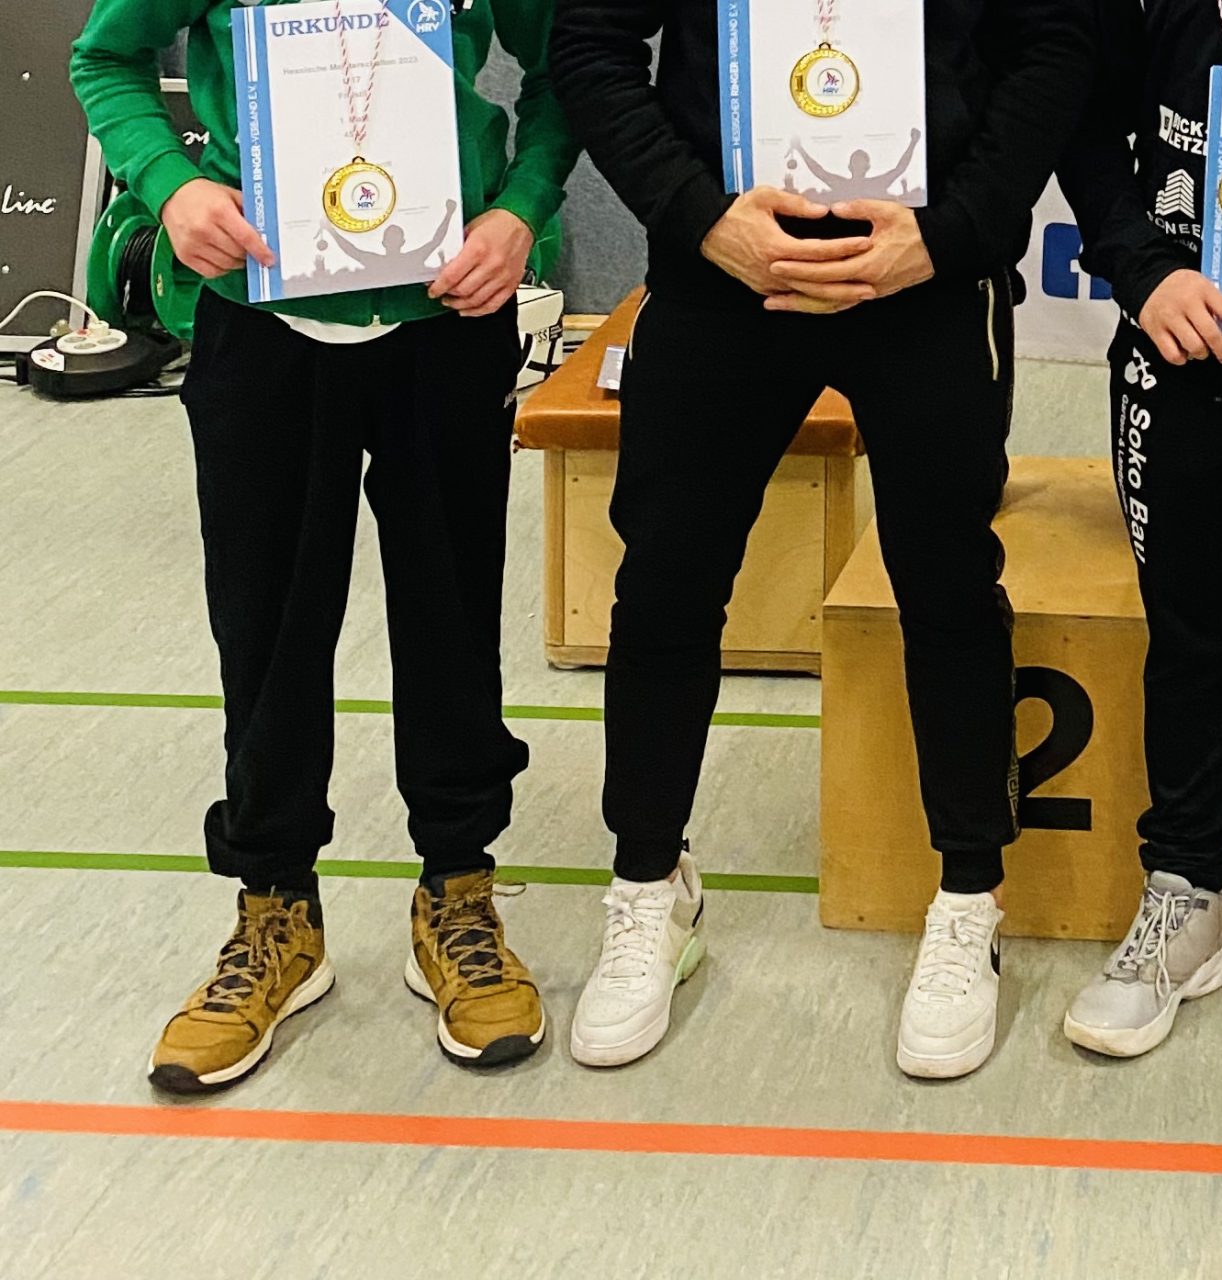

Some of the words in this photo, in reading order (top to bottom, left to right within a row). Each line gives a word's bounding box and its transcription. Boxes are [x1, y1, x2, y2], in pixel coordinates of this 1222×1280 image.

[270, 11, 391, 37] URKUNDE
[415, 20, 439, 34] HRV
[1127, 403, 1151, 490] Soko
[1129, 496, 1149, 564] Bau
[1013, 665, 1095, 832] 2
